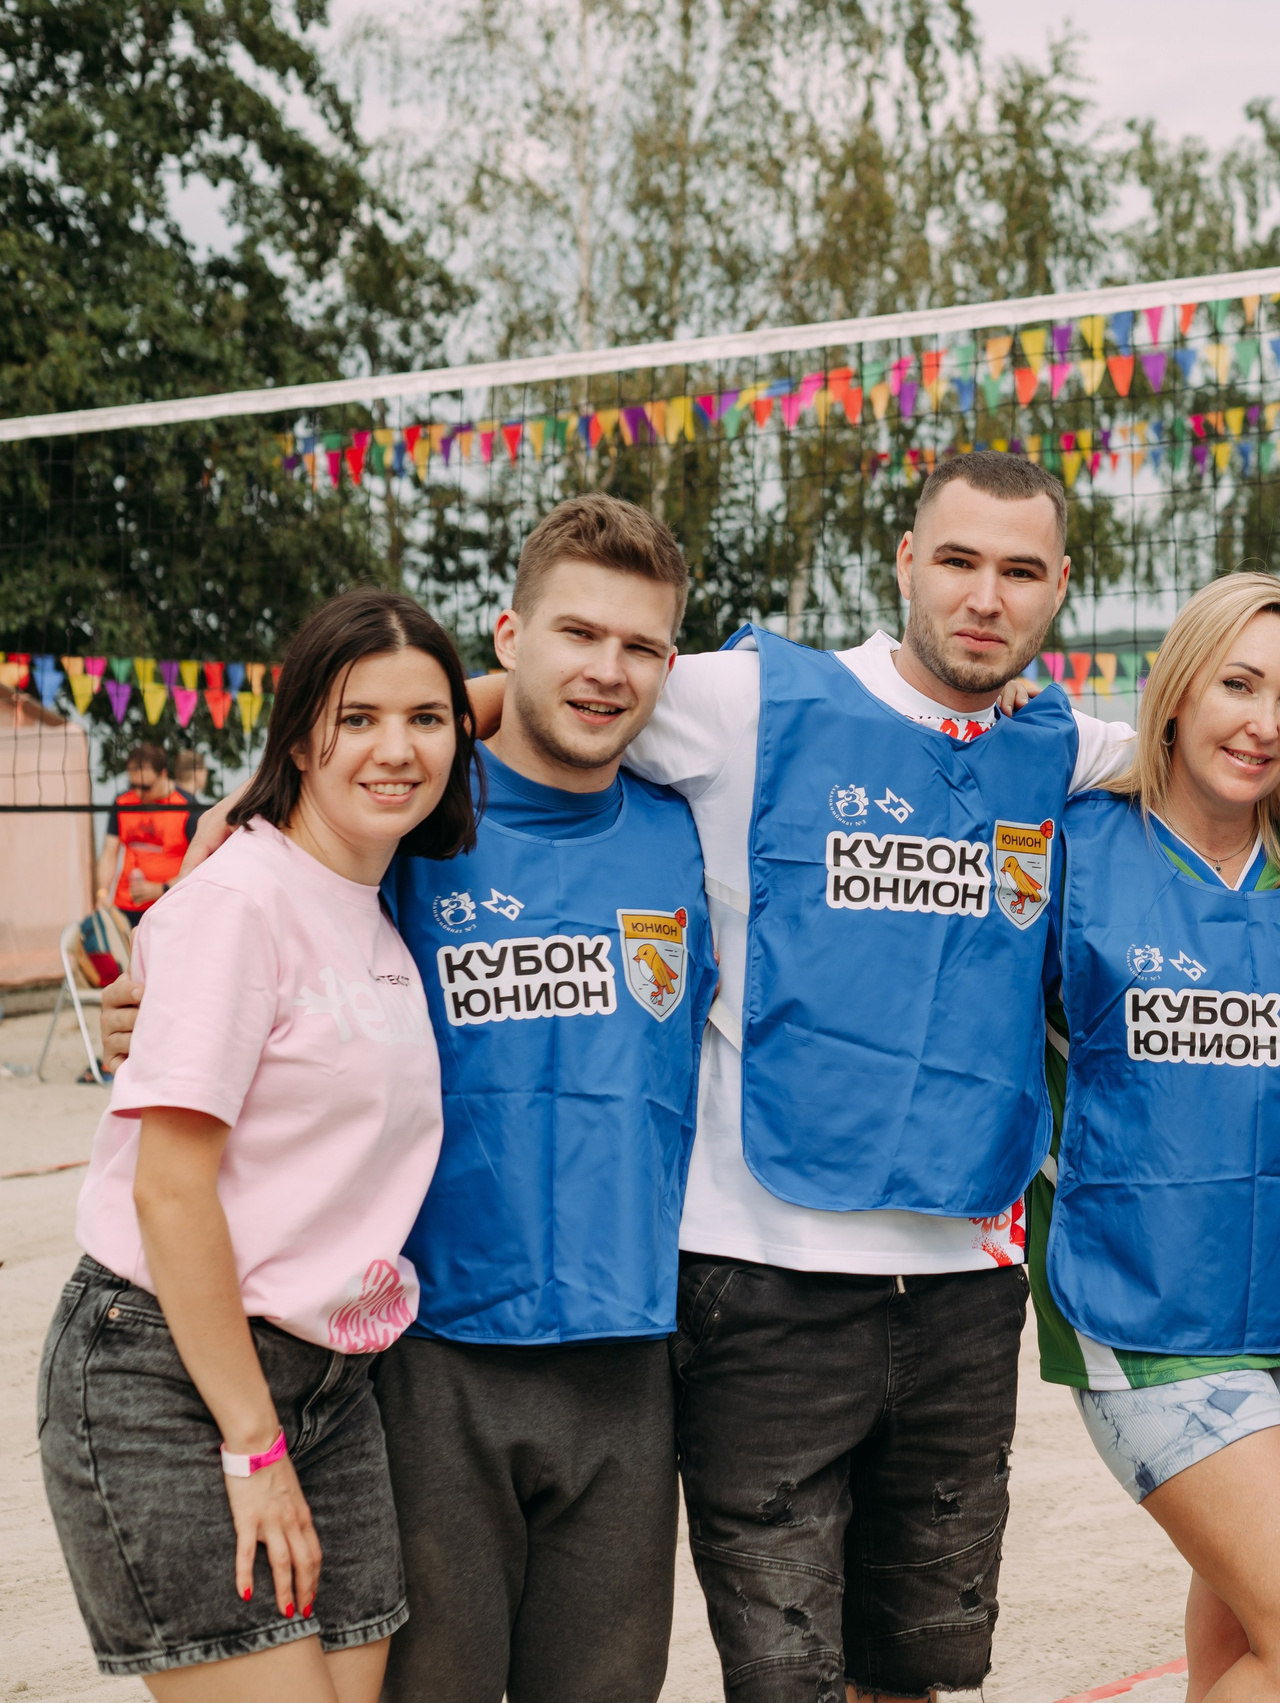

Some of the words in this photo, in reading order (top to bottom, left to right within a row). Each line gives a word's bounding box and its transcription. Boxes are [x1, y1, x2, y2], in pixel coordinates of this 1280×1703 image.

[833, 837, 985, 878] КУБОК
[1001, 833, 1042, 848] ЮНИОН
[833, 875, 984, 910] ЮНИОН
[631, 922, 678, 937] ЮНИОН
[444, 942, 607, 984] КУБОК
[451, 980, 609, 1019] ЮНИОН
[1131, 994, 1278, 1028] КУБОК
[1134, 1030, 1277, 1060] ЮНИОН
